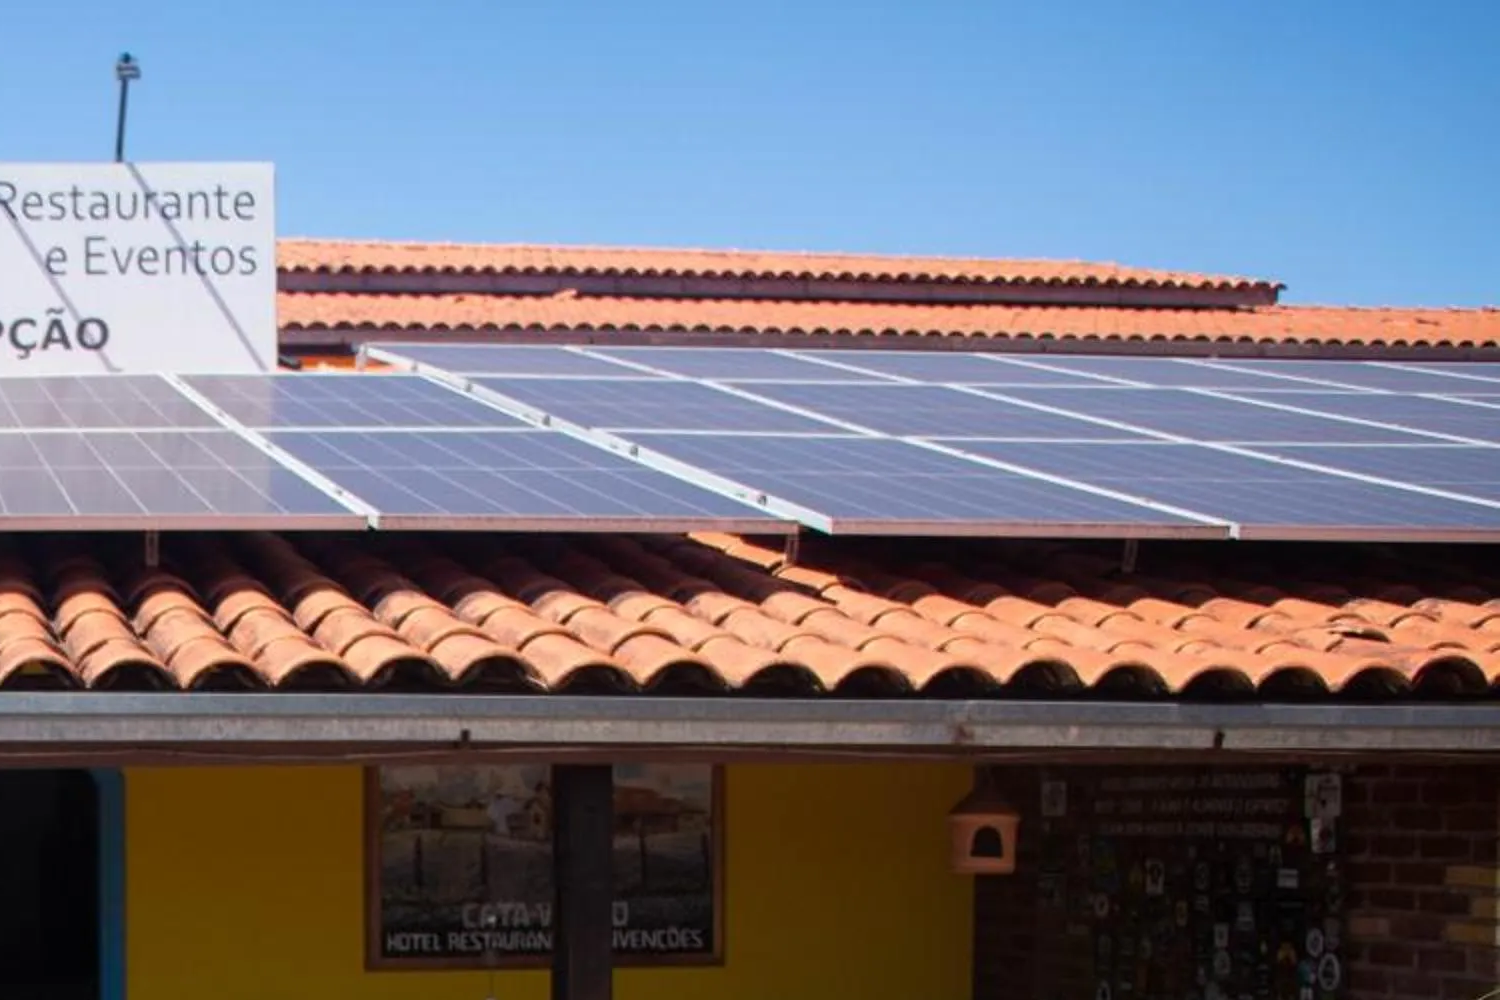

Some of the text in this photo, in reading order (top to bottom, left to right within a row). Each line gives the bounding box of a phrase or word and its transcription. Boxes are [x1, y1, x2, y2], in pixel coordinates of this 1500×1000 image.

[44, 236, 258, 276] e Eventos
[386, 924, 705, 952] HOTEL RESTAURAN VENÇÕES
